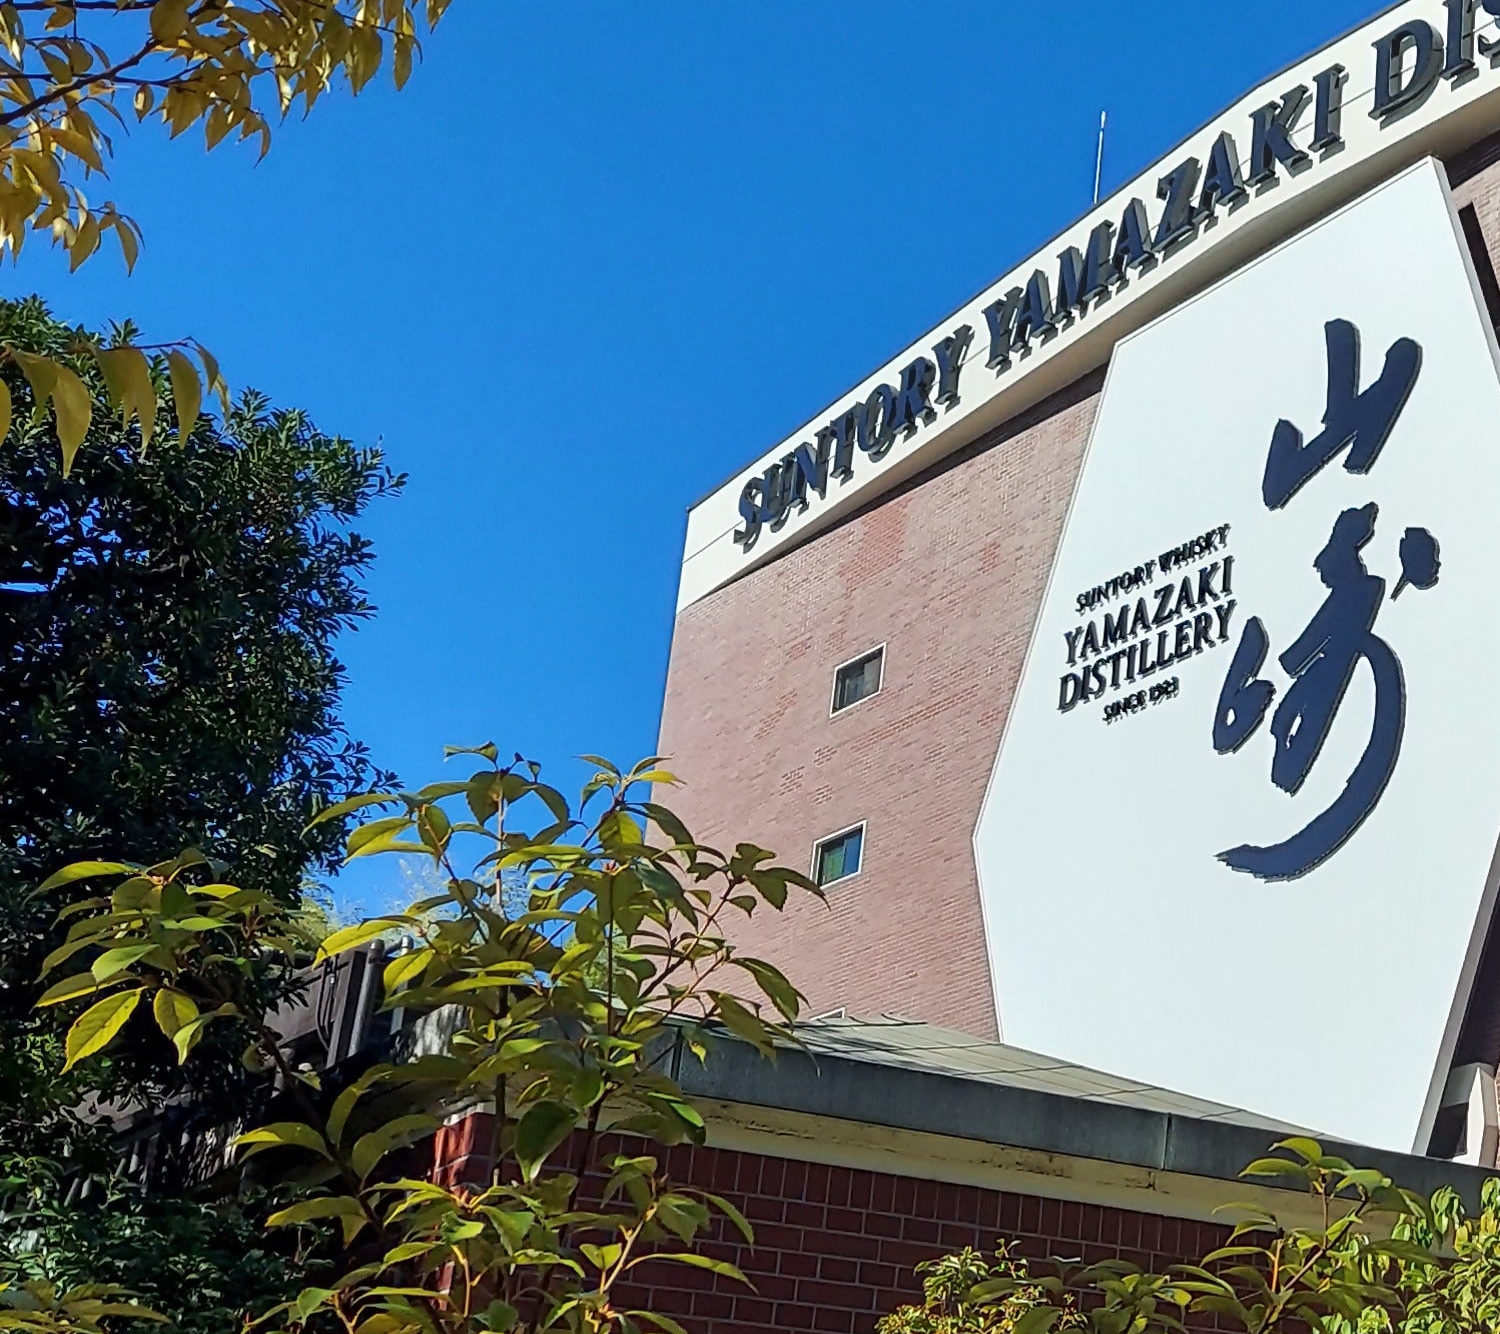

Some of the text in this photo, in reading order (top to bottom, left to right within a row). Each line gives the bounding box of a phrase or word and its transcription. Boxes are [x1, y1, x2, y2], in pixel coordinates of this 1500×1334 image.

[733, 324, 975, 553] SUNTORY
[981, 63, 1349, 378] YAMAZAKI
[1063, 555, 1235, 668] YAMAZAKI
[1075, 523, 1231, 616] SUNTORY WHISKY
[1057, 599, 1237, 715] DISTILLERY
